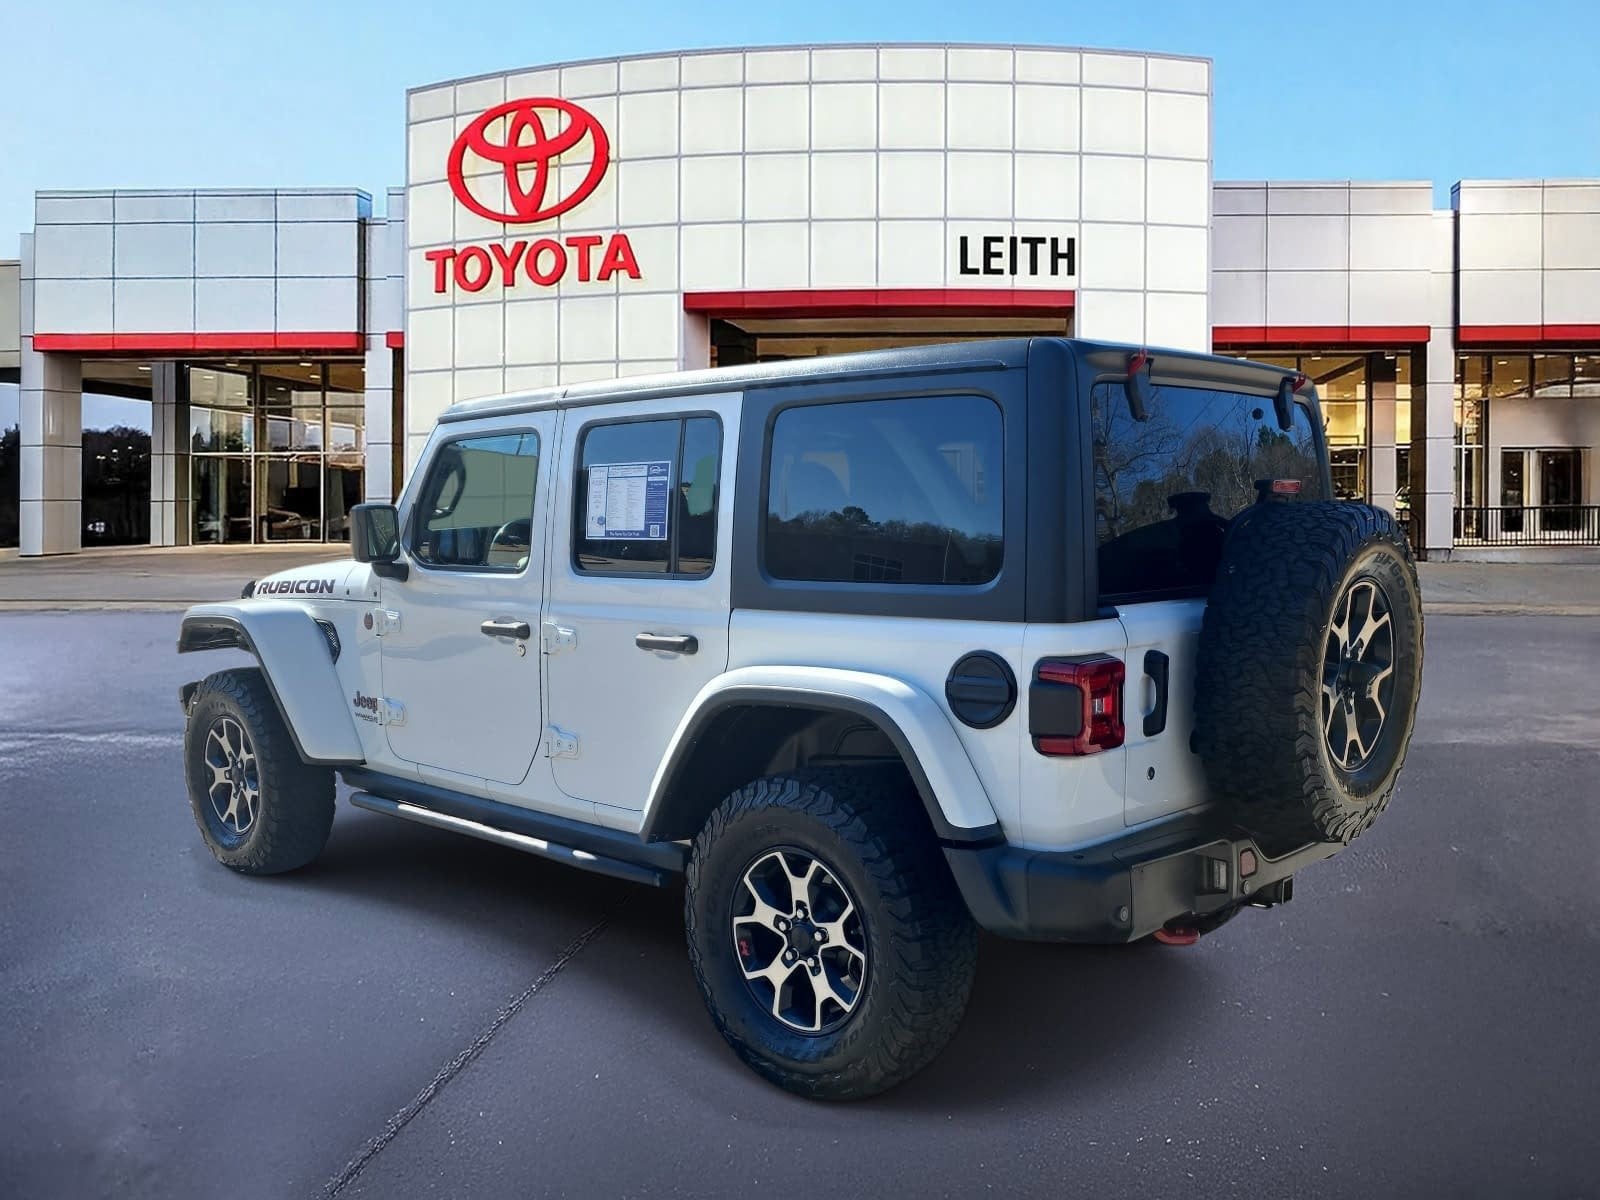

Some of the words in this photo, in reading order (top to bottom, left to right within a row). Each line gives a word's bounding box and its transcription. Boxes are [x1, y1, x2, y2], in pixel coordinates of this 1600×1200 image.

[425, 234, 641, 294] TOYOTA
[959, 235, 1076, 276] LEITH
[257, 579, 336, 595] RUBICON
[353, 690, 378, 714] Jeep
